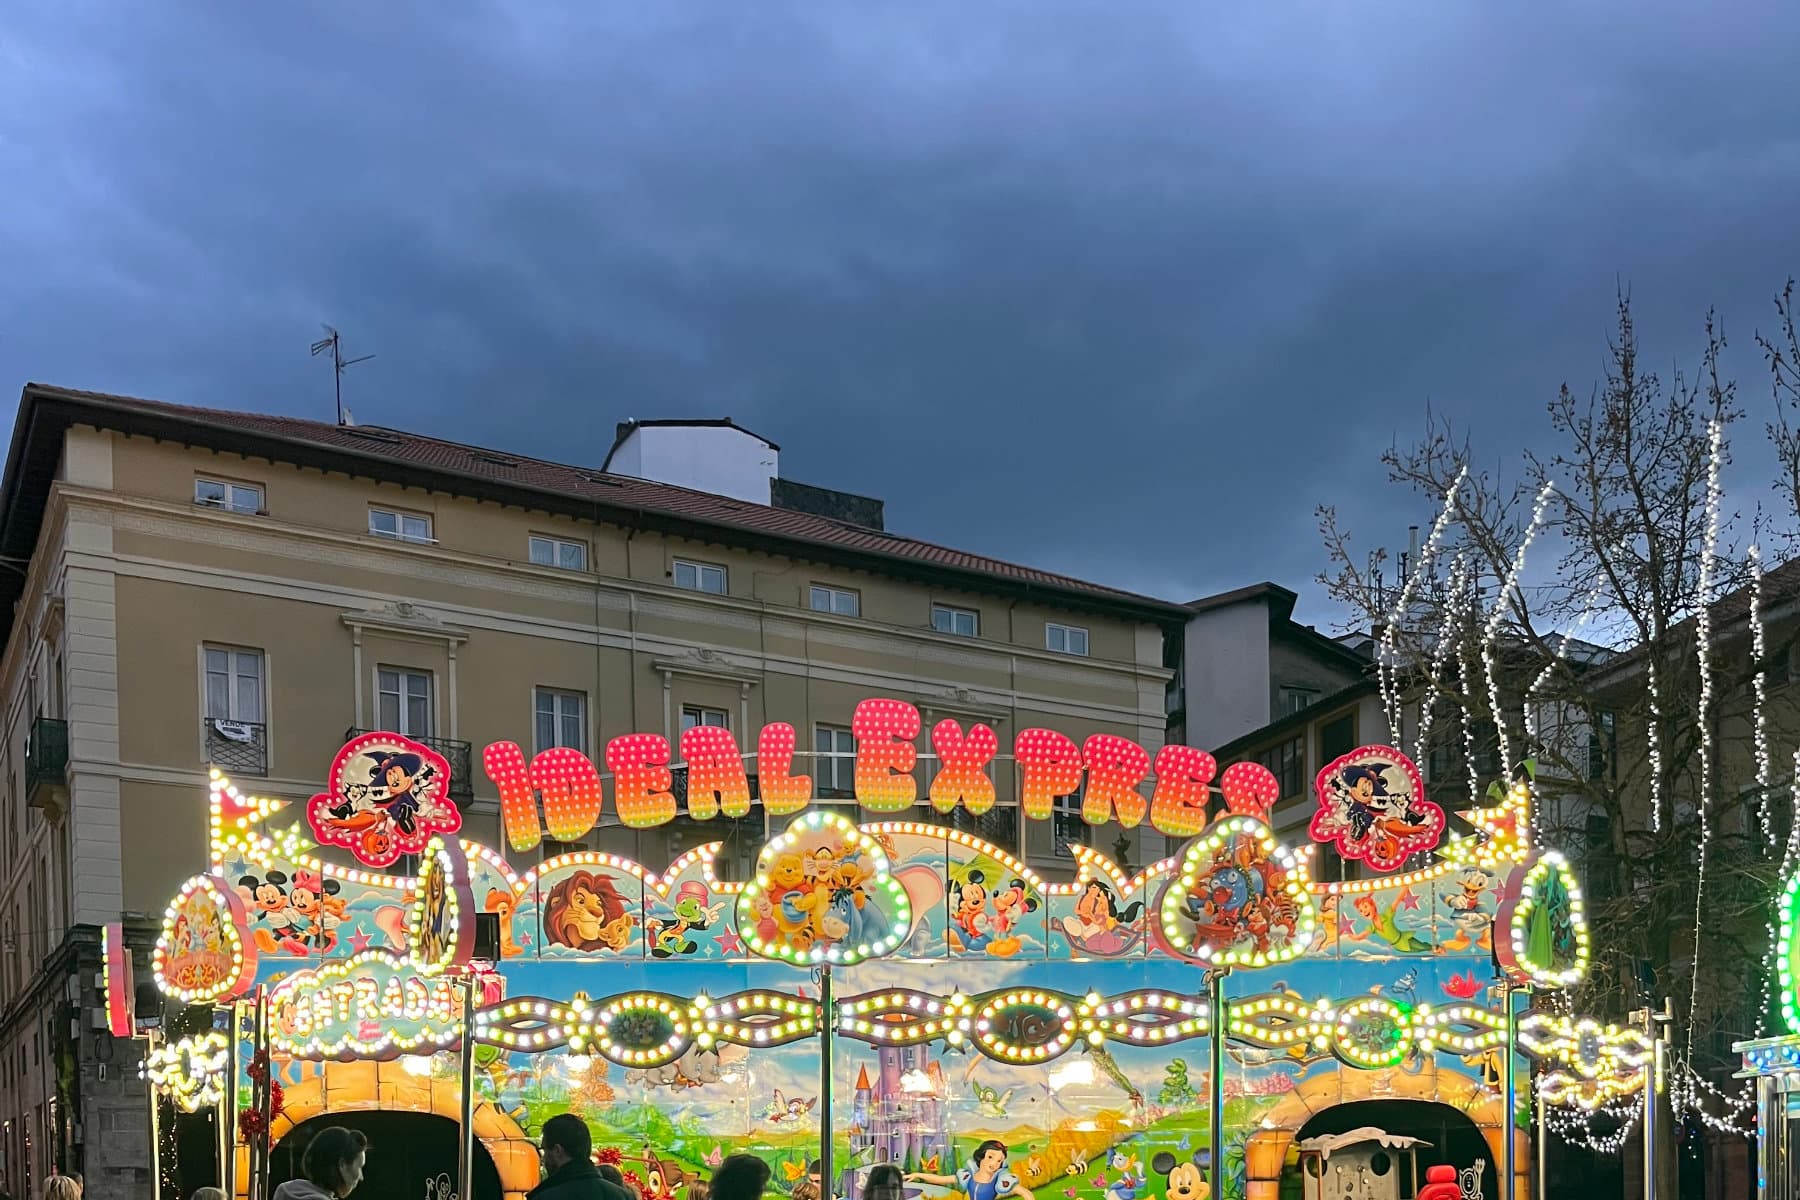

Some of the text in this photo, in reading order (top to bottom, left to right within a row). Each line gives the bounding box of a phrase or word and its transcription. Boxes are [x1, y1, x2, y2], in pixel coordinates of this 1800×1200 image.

[482, 697, 1280, 853] IDEAL EXPRES
[294, 976, 451, 1035] ENTRADA
